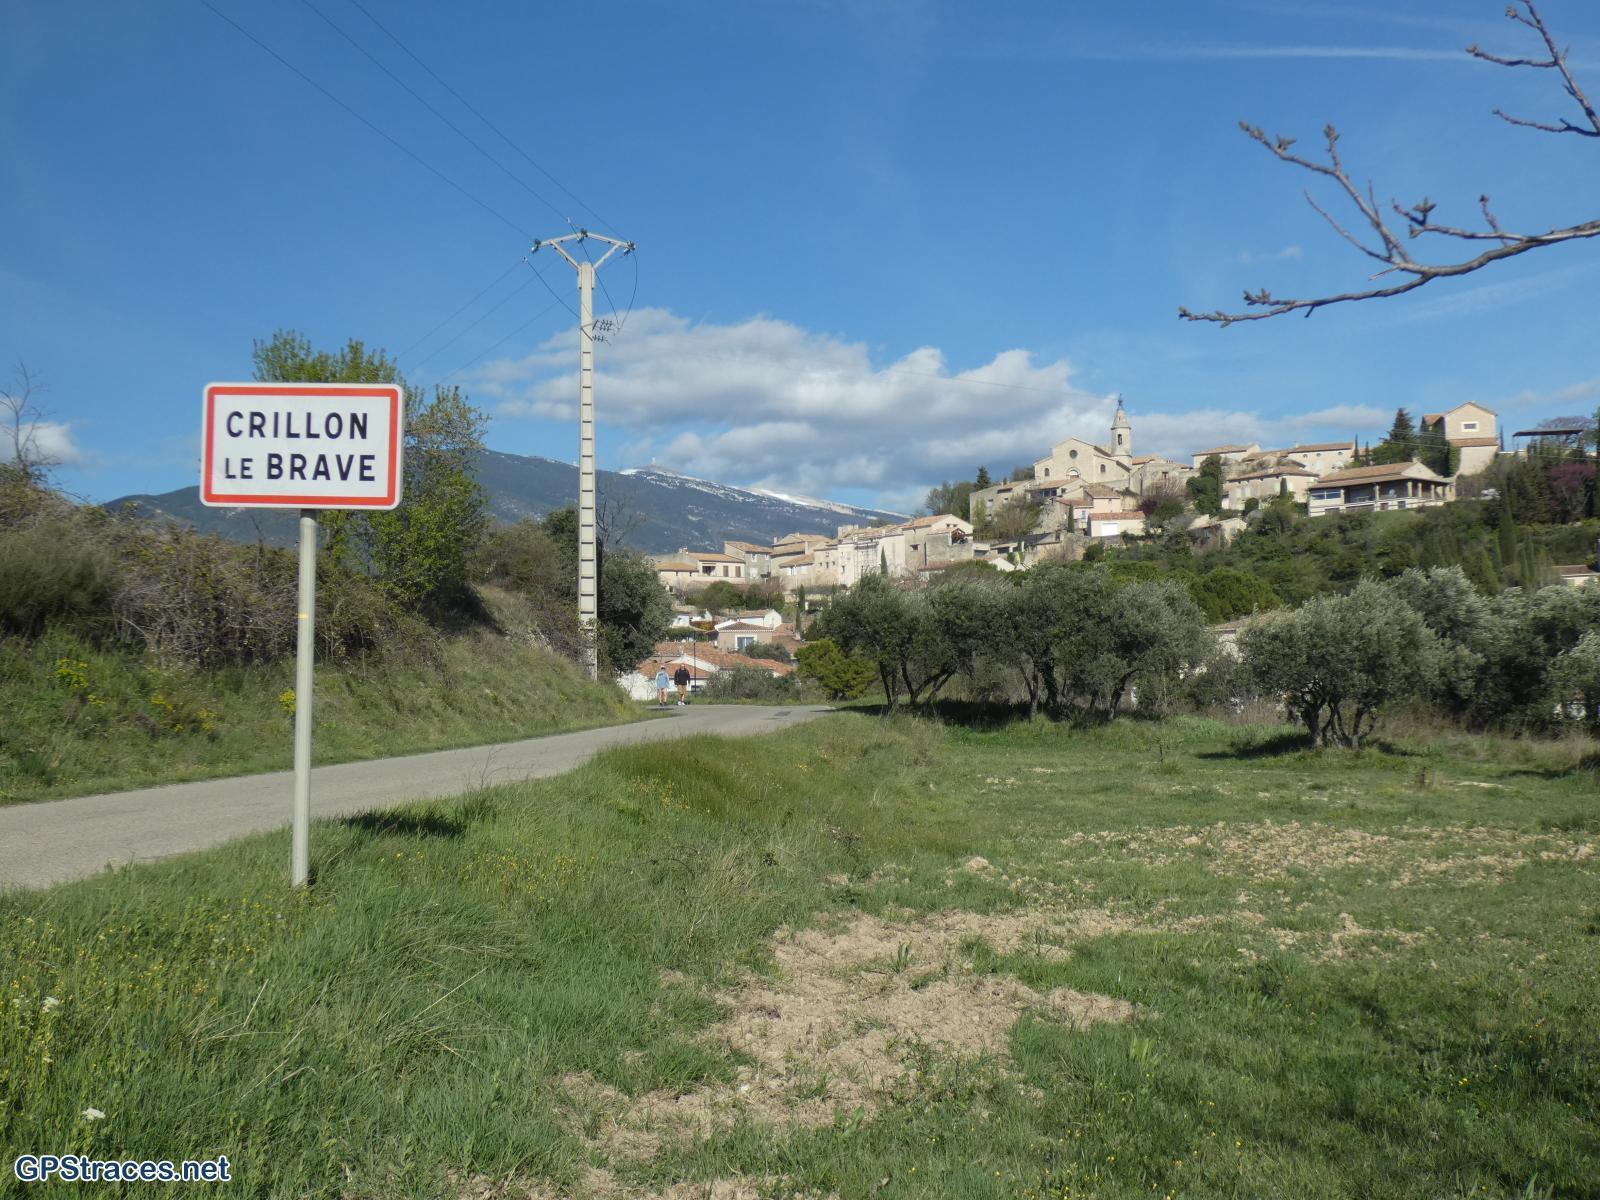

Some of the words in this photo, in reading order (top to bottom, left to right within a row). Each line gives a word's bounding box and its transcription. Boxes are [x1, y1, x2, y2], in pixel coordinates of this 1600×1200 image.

[226, 411, 368, 439] CRILLON
[225, 457, 253, 480] LE
[267, 453, 376, 482] BRAVE
